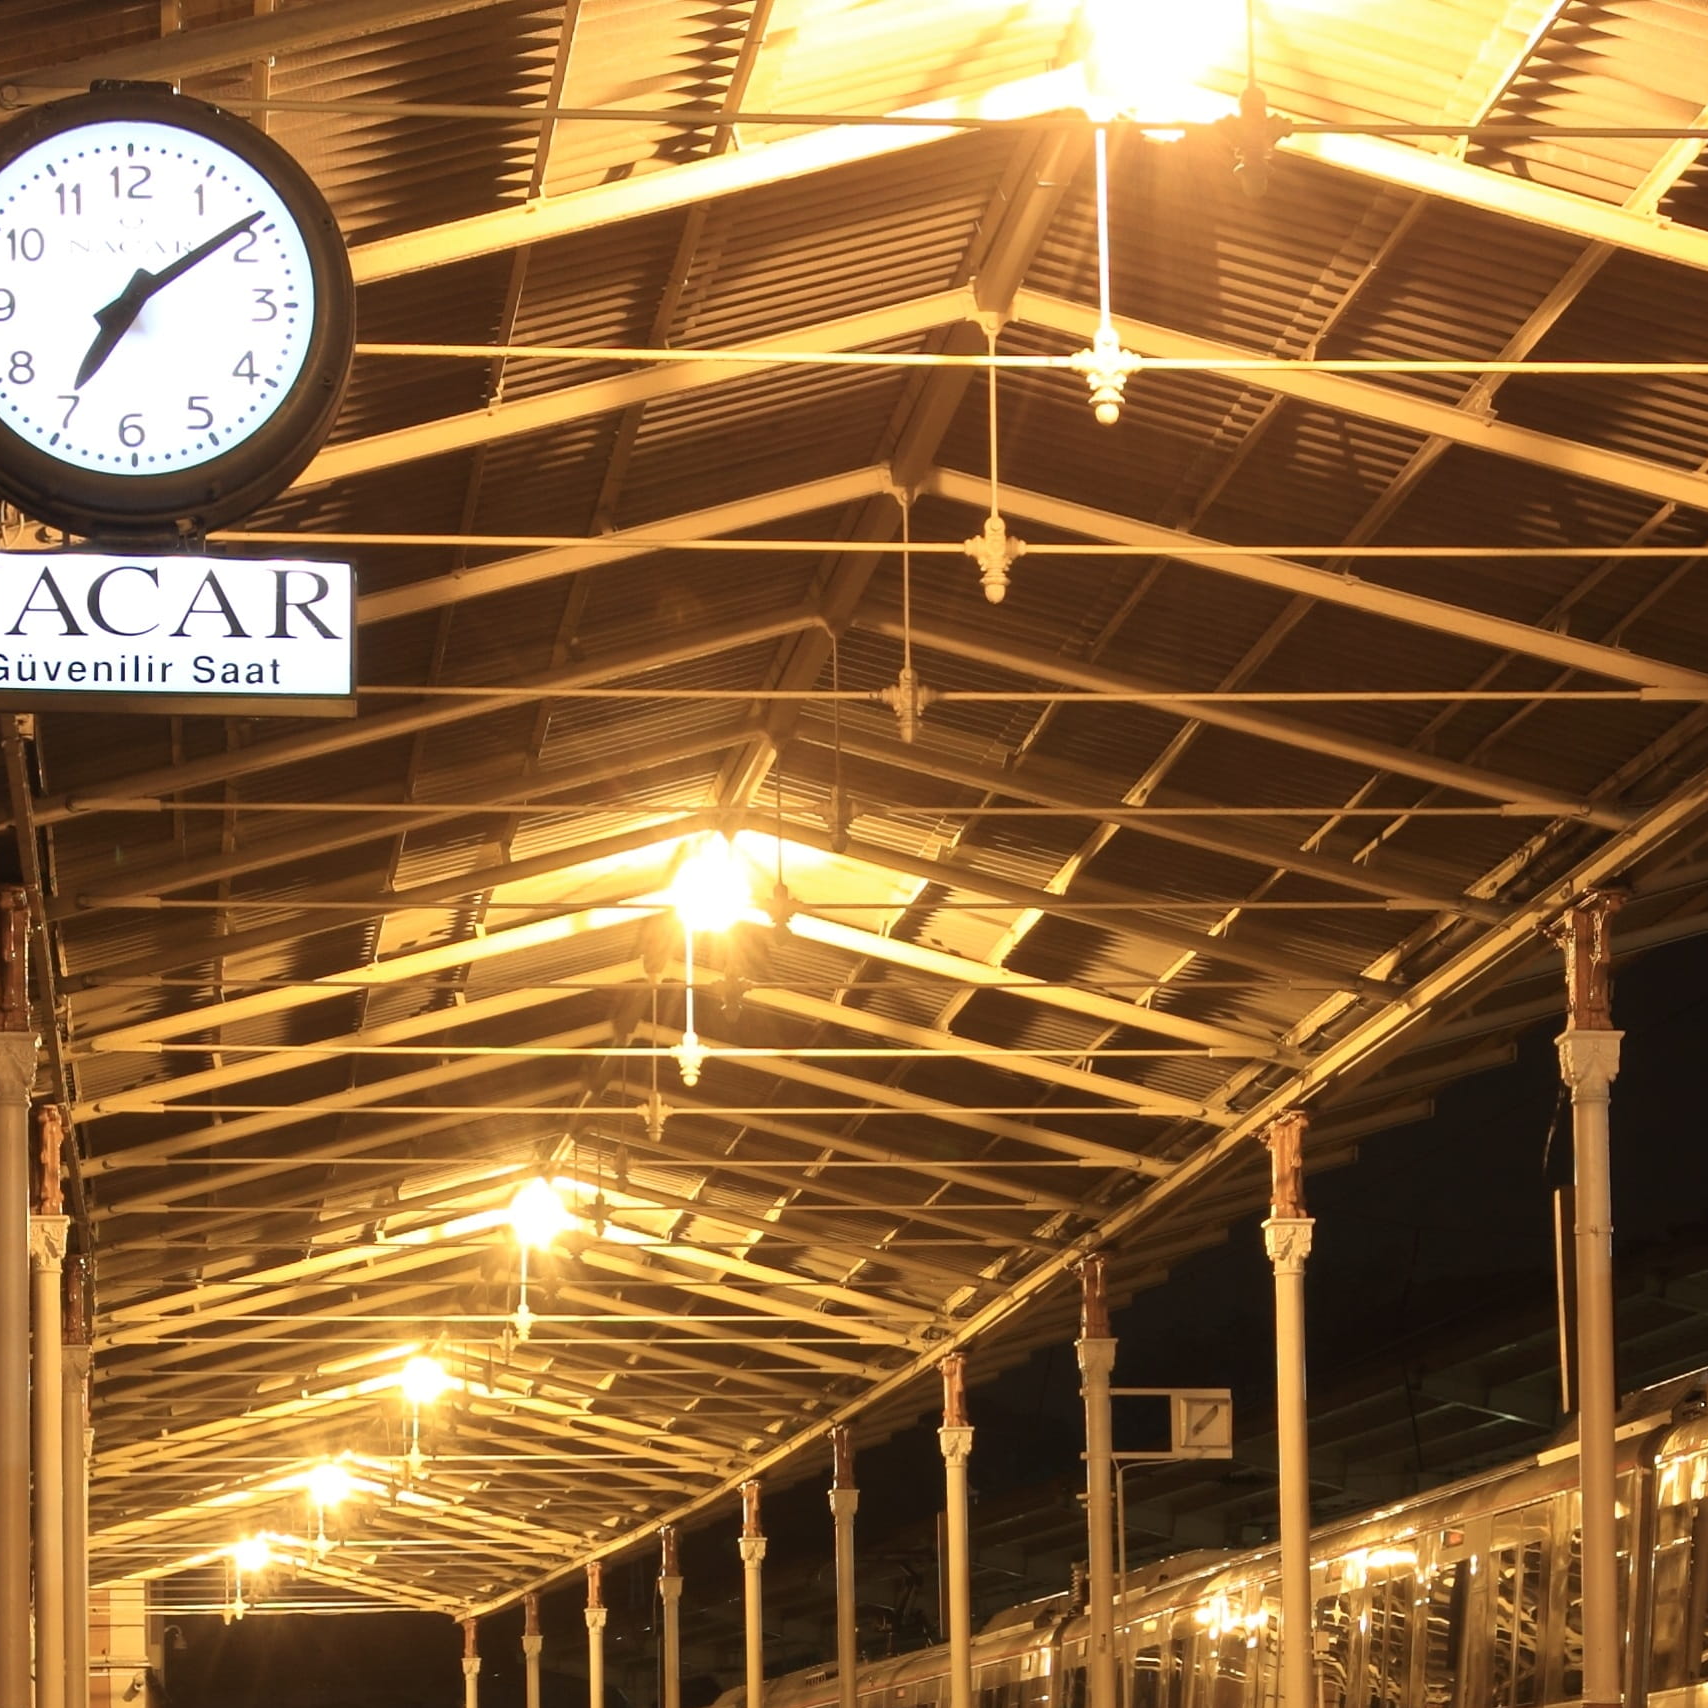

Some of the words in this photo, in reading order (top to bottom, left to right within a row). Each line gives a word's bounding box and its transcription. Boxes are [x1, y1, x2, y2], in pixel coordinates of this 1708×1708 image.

[54, 182, 82, 216] 11
[108, 165, 153, 199] 12
[193, 183, 204, 216] 1
[6, 227, 45, 262] 10
[232, 228, 259, 263] 2
[251, 288, 278, 322] 3
[7, 350, 35, 385] 8
[231, 350, 261, 385] 4
[56, 395, 80, 430] 7
[186, 396, 214, 430] 5
[117, 413, 145, 448] 6
[192, 655, 281, 685] Saat
